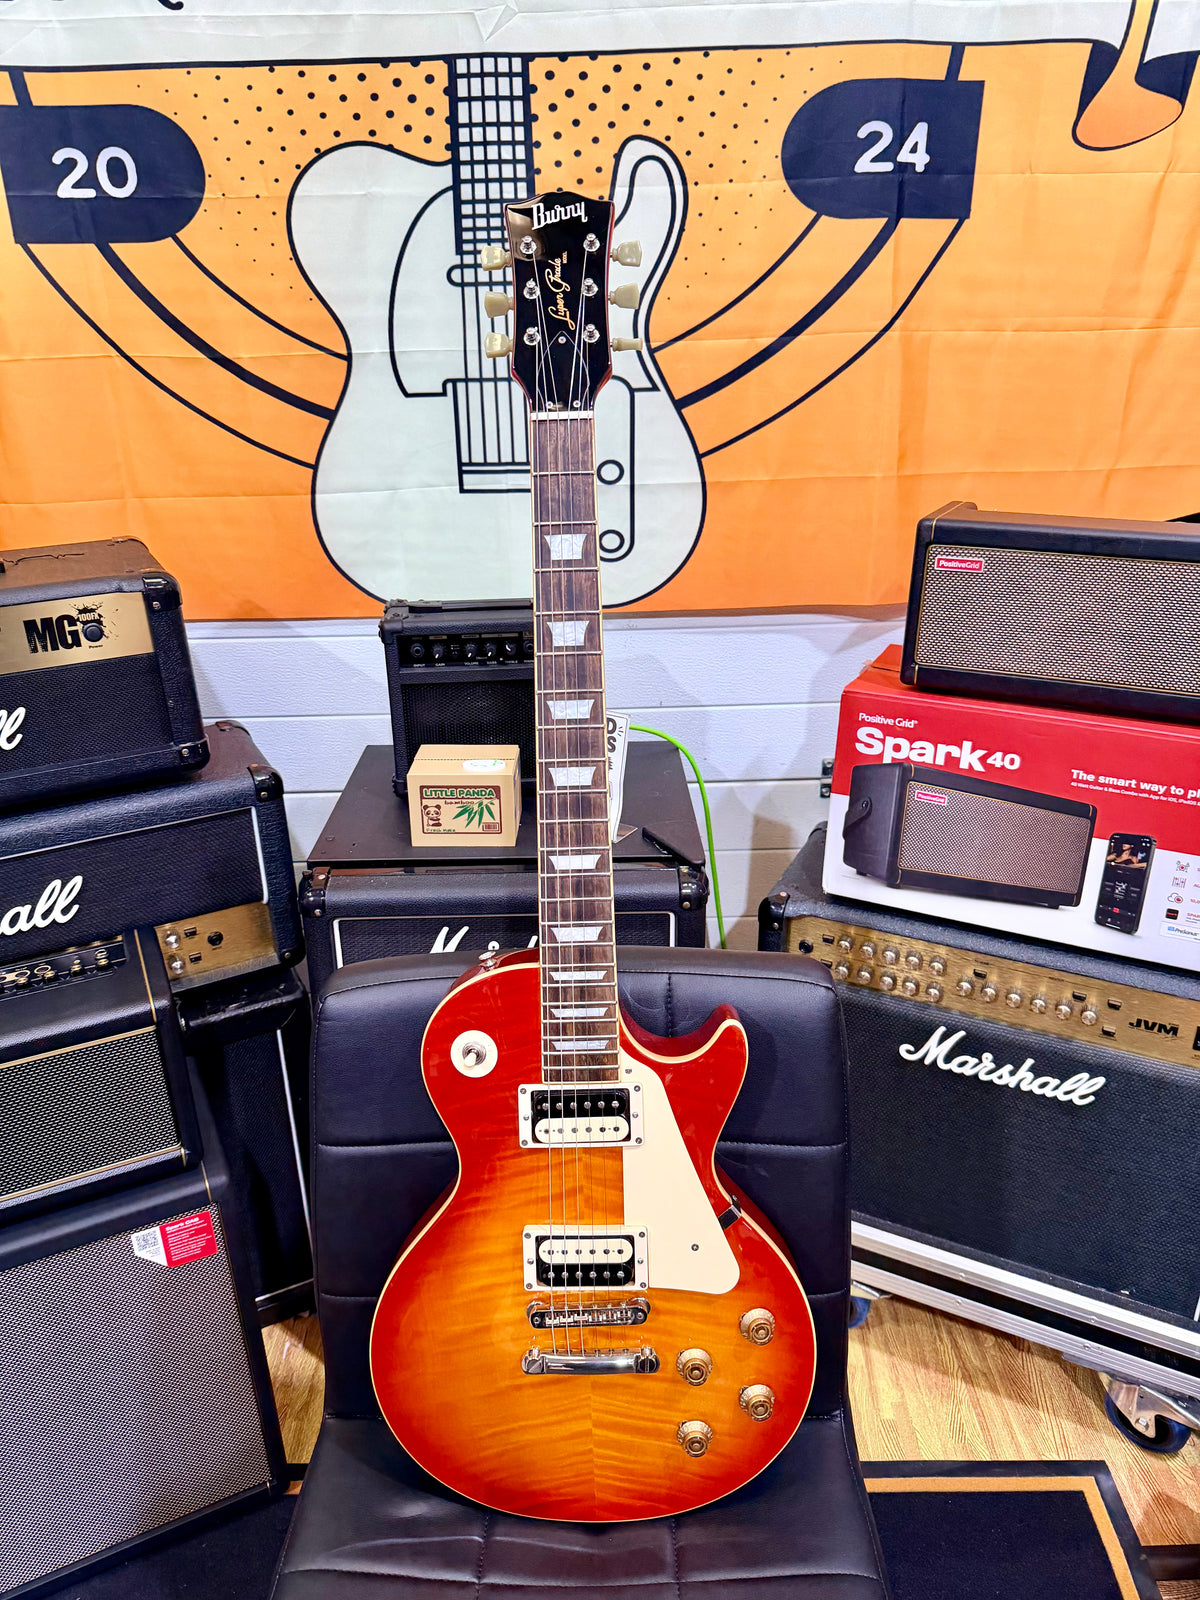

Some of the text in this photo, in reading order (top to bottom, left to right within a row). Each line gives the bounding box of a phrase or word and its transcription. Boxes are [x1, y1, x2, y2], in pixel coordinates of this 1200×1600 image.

[854, 120, 930, 173] 24
[52, 146, 138, 198] 20
[531, 202, 588, 230] Burny
[939, 560, 980, 569] PositiveGrid
[23, 614, 82, 654] MG
[859, 712, 895, 726] Positive
[855, 726, 1021, 772] Spark 40
[424, 789, 495, 797] LITTLE PANDA
[1071, 769, 1095, 781] The
[1098, 775, 1137, 788] smart
[1140, 781, 1167, 794] way
[1170, 785, 1184, 795] to
[1128, 1018, 1180, 1037] JVM
[899, 1026, 1106, 1106] Marshall
